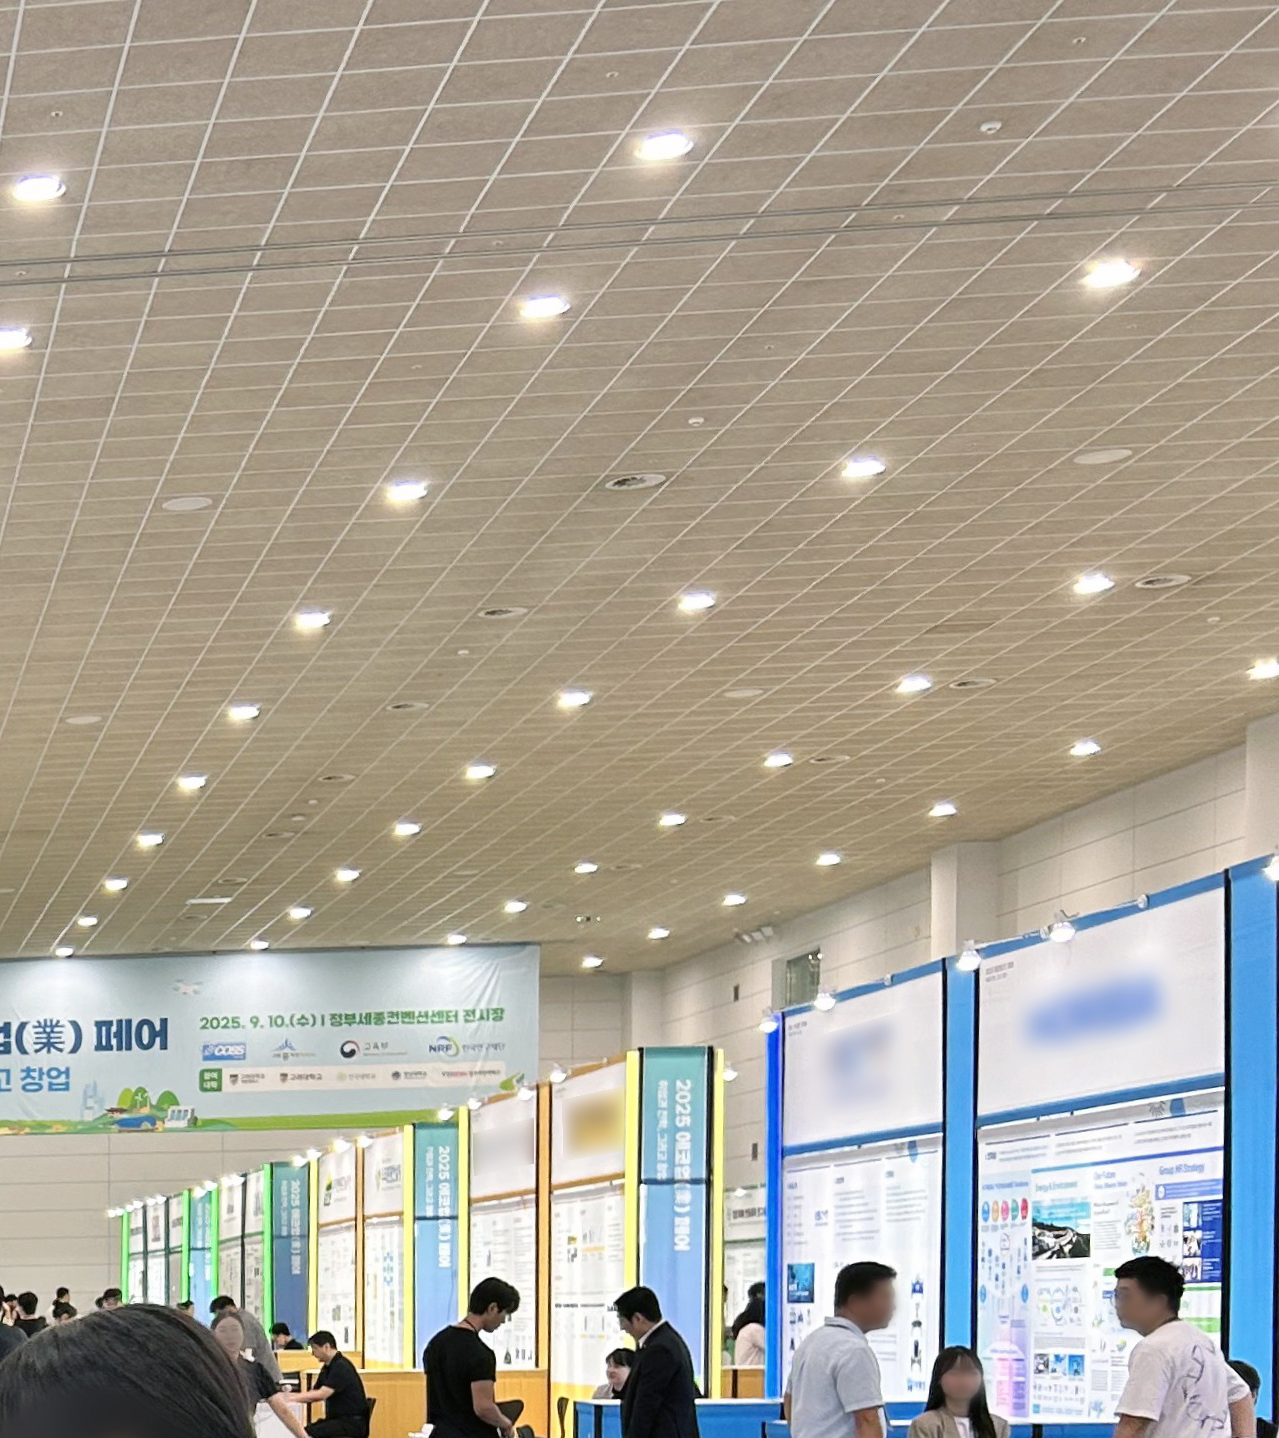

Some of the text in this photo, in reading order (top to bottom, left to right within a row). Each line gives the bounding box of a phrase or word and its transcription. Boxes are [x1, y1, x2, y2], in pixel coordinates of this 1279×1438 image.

[94, 1017, 168, 1052] 페어
[199, 1016, 245, 1030] 2025.
[329, 1009, 459, 1028] 정부세종컨벤션센터
[463, 1007, 505, 1023] 전시장
[20, 1066, 71, 1093] 창업
[673, 1079, 691, 1128] 2025
[438, 1146, 450, 1179] 2025
[673, 1216, 691, 1251] 페어
